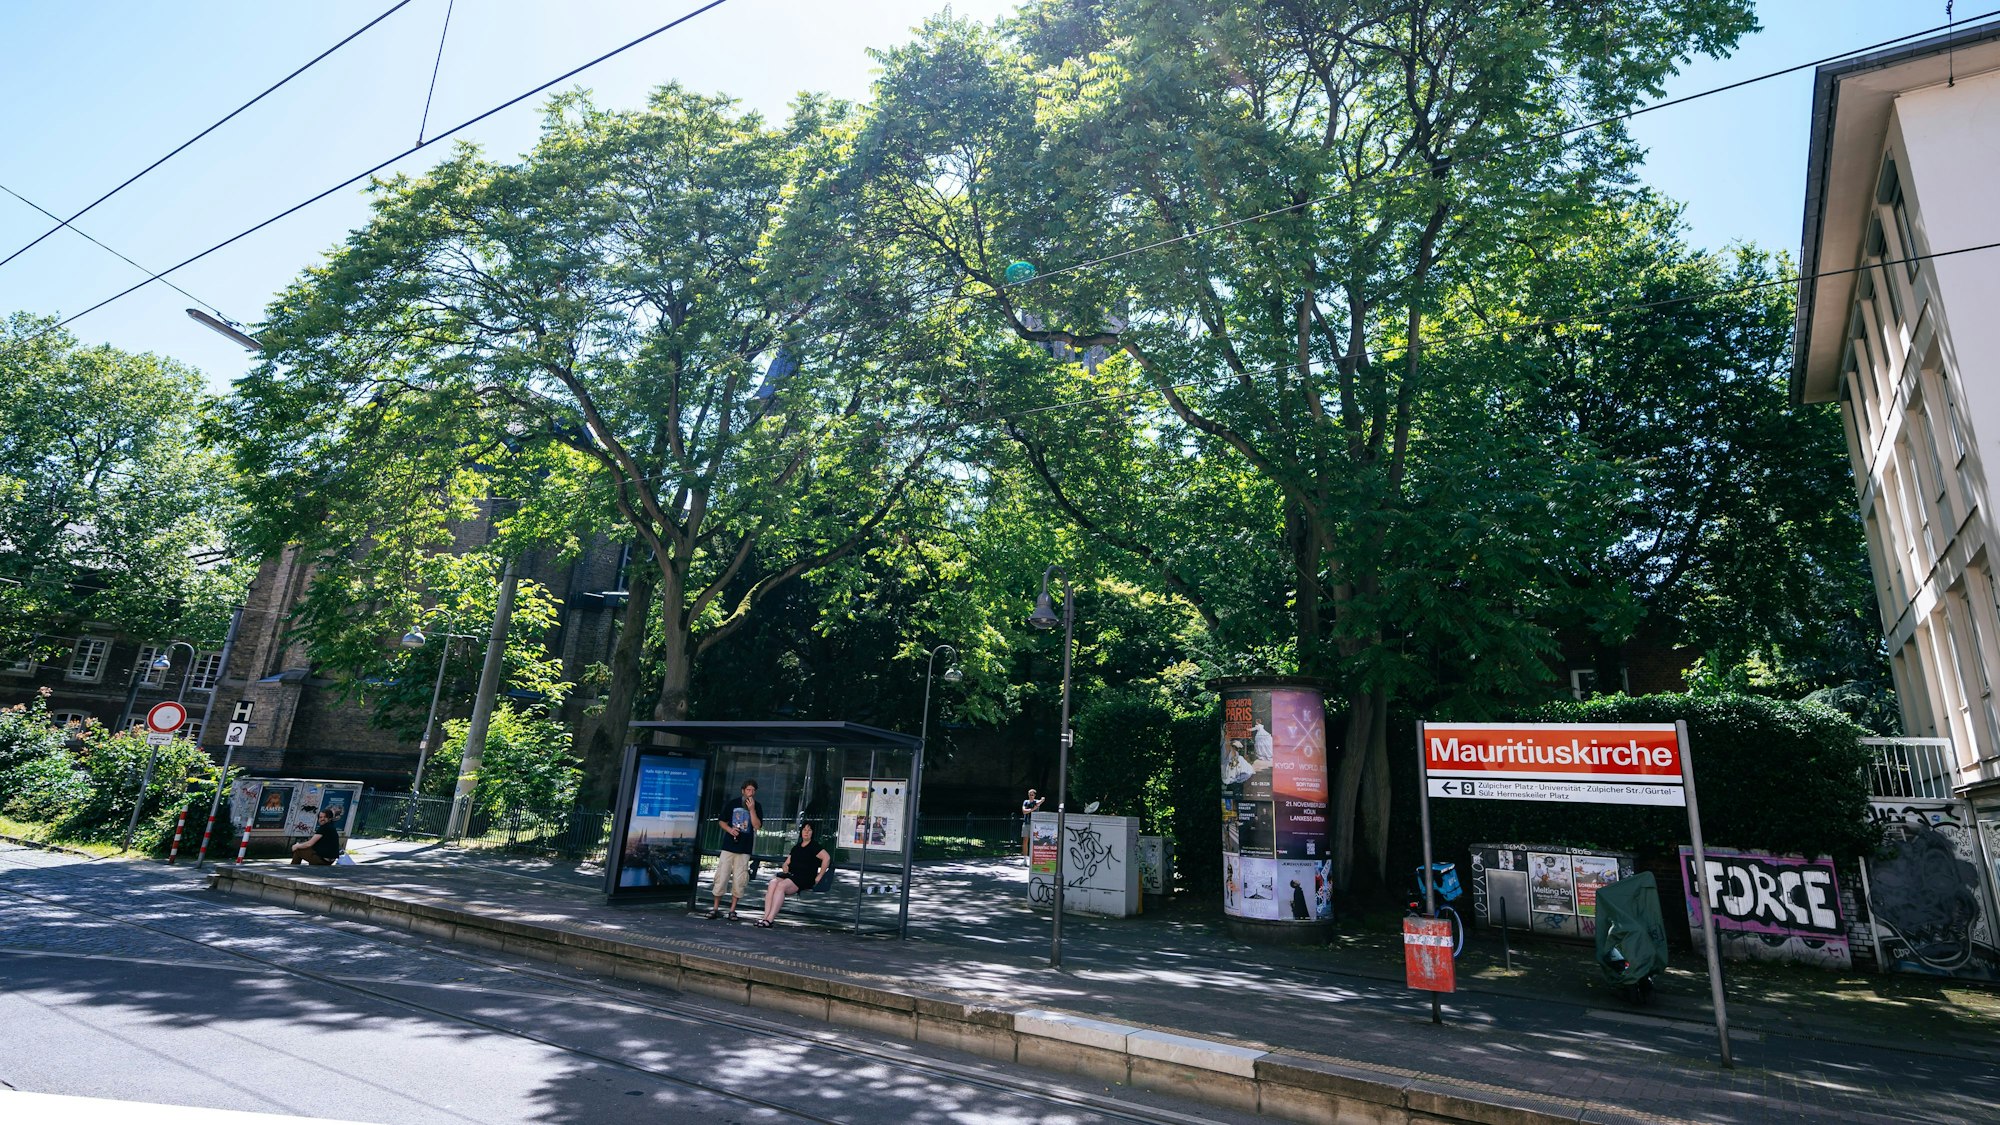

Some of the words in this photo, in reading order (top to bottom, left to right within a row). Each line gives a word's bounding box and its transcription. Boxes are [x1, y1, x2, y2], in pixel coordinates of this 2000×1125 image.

[231, 702, 254, 721] H
[1225, 707, 1252, 721] PARIS
[1430, 737, 1673, 767] Mauritiuskirche
[1463, 783, 1472, 794] 9
[1478, 782, 1512, 791] Zülpicher
[1497, 791, 1546, 799] Hermeskeiler
[1533, 885, 1560, 897] Melting
[1560, 887, 1573, 897] Pot
